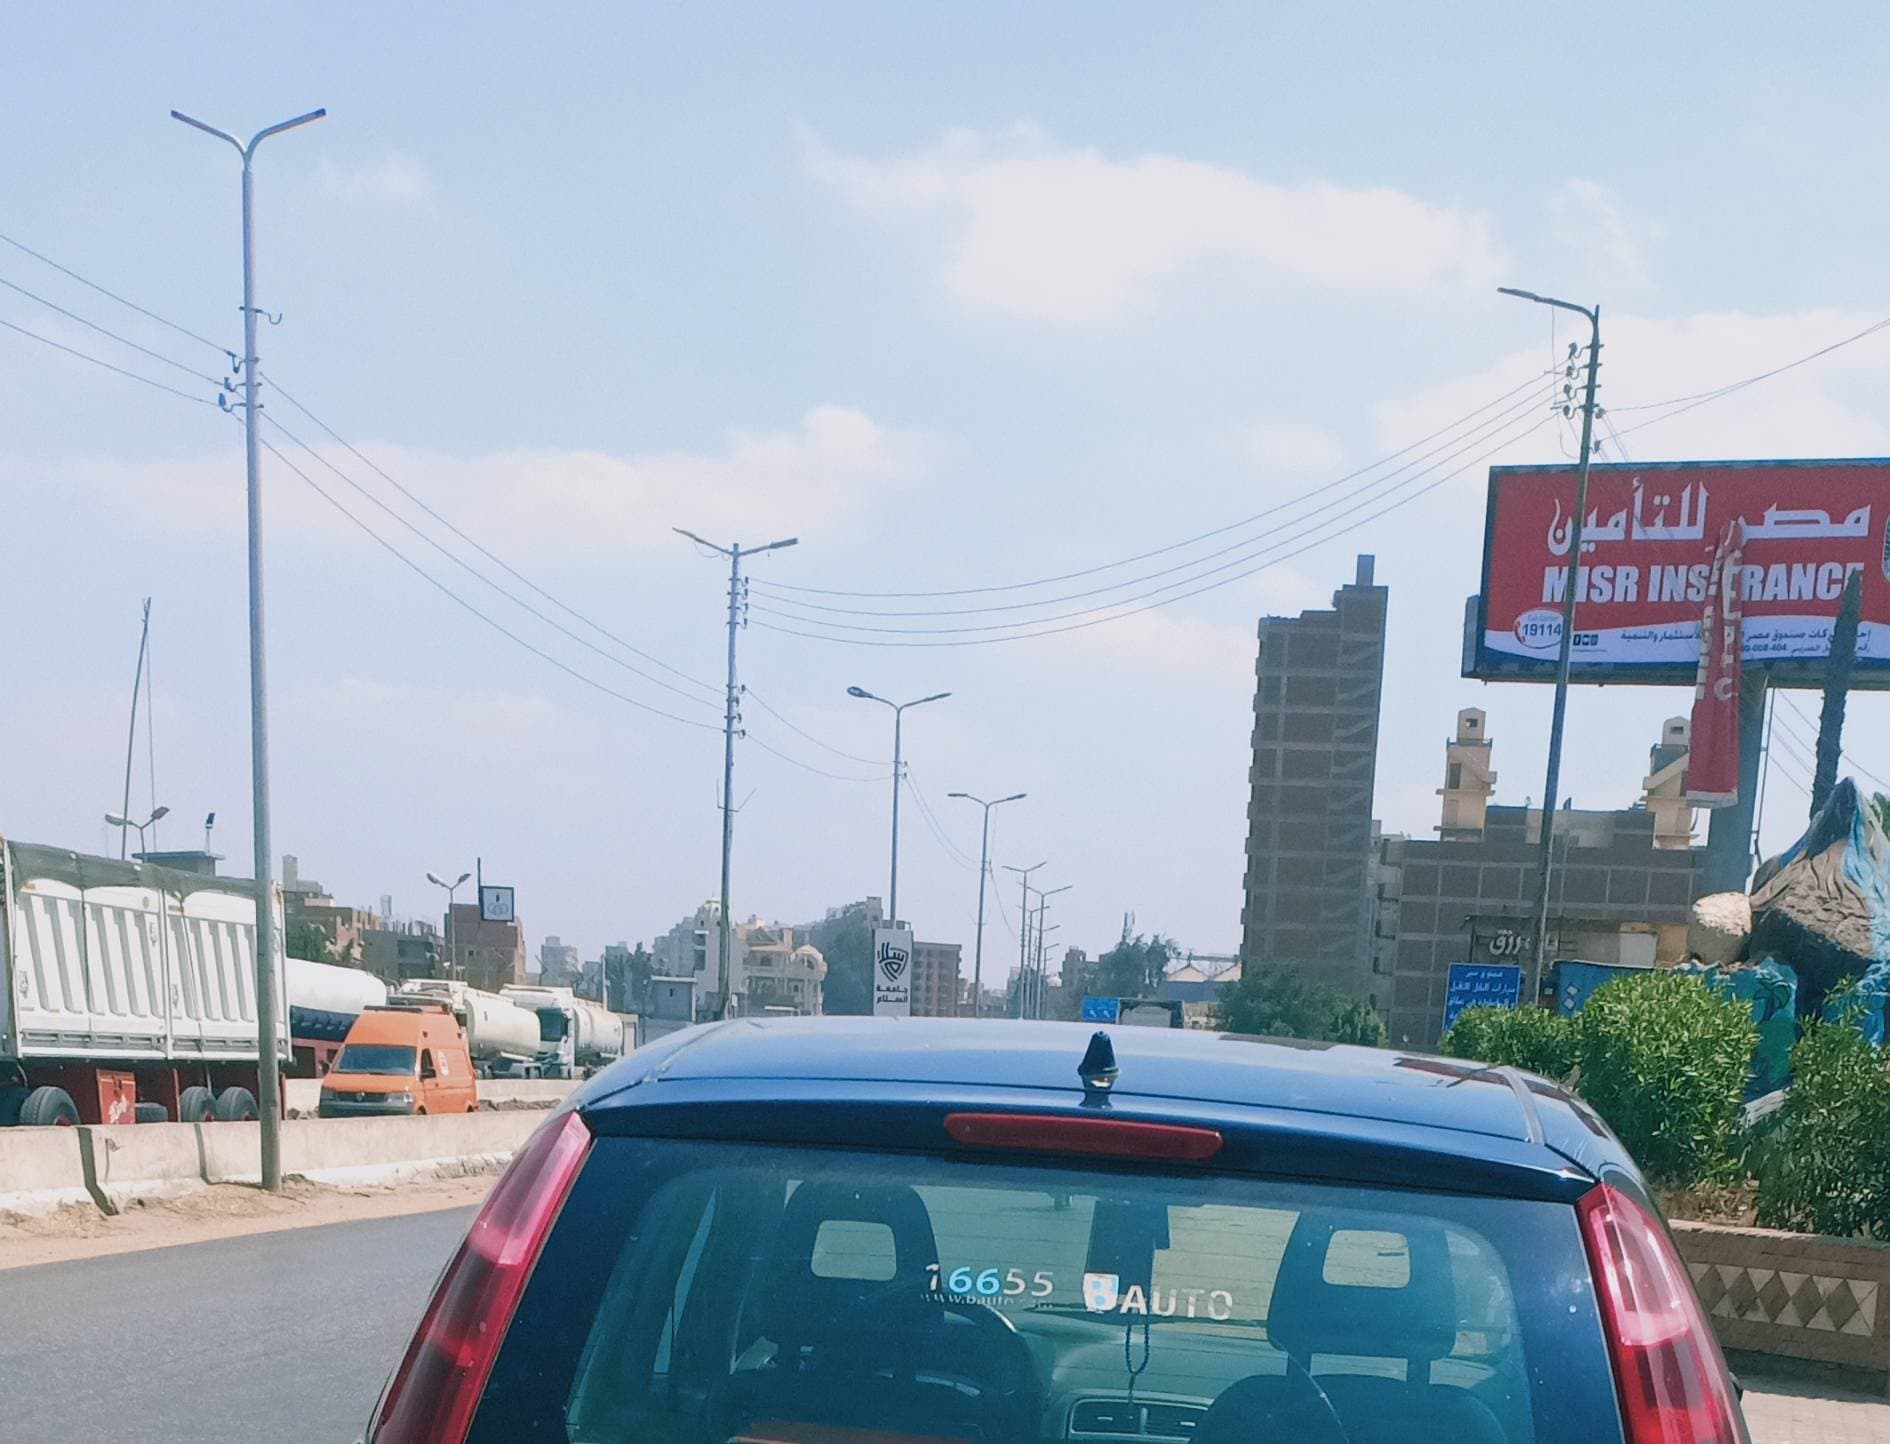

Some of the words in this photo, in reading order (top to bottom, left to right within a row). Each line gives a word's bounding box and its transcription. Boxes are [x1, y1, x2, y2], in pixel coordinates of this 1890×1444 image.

[1547, 477, 1710, 557] للتأمين
[1541, 563, 1640, 604] MISR
[1647, 561, 1865, 604] INSRANC
[1522, 622, 1562, 638] 19114
[925, 1263, 1055, 1297] 16655
